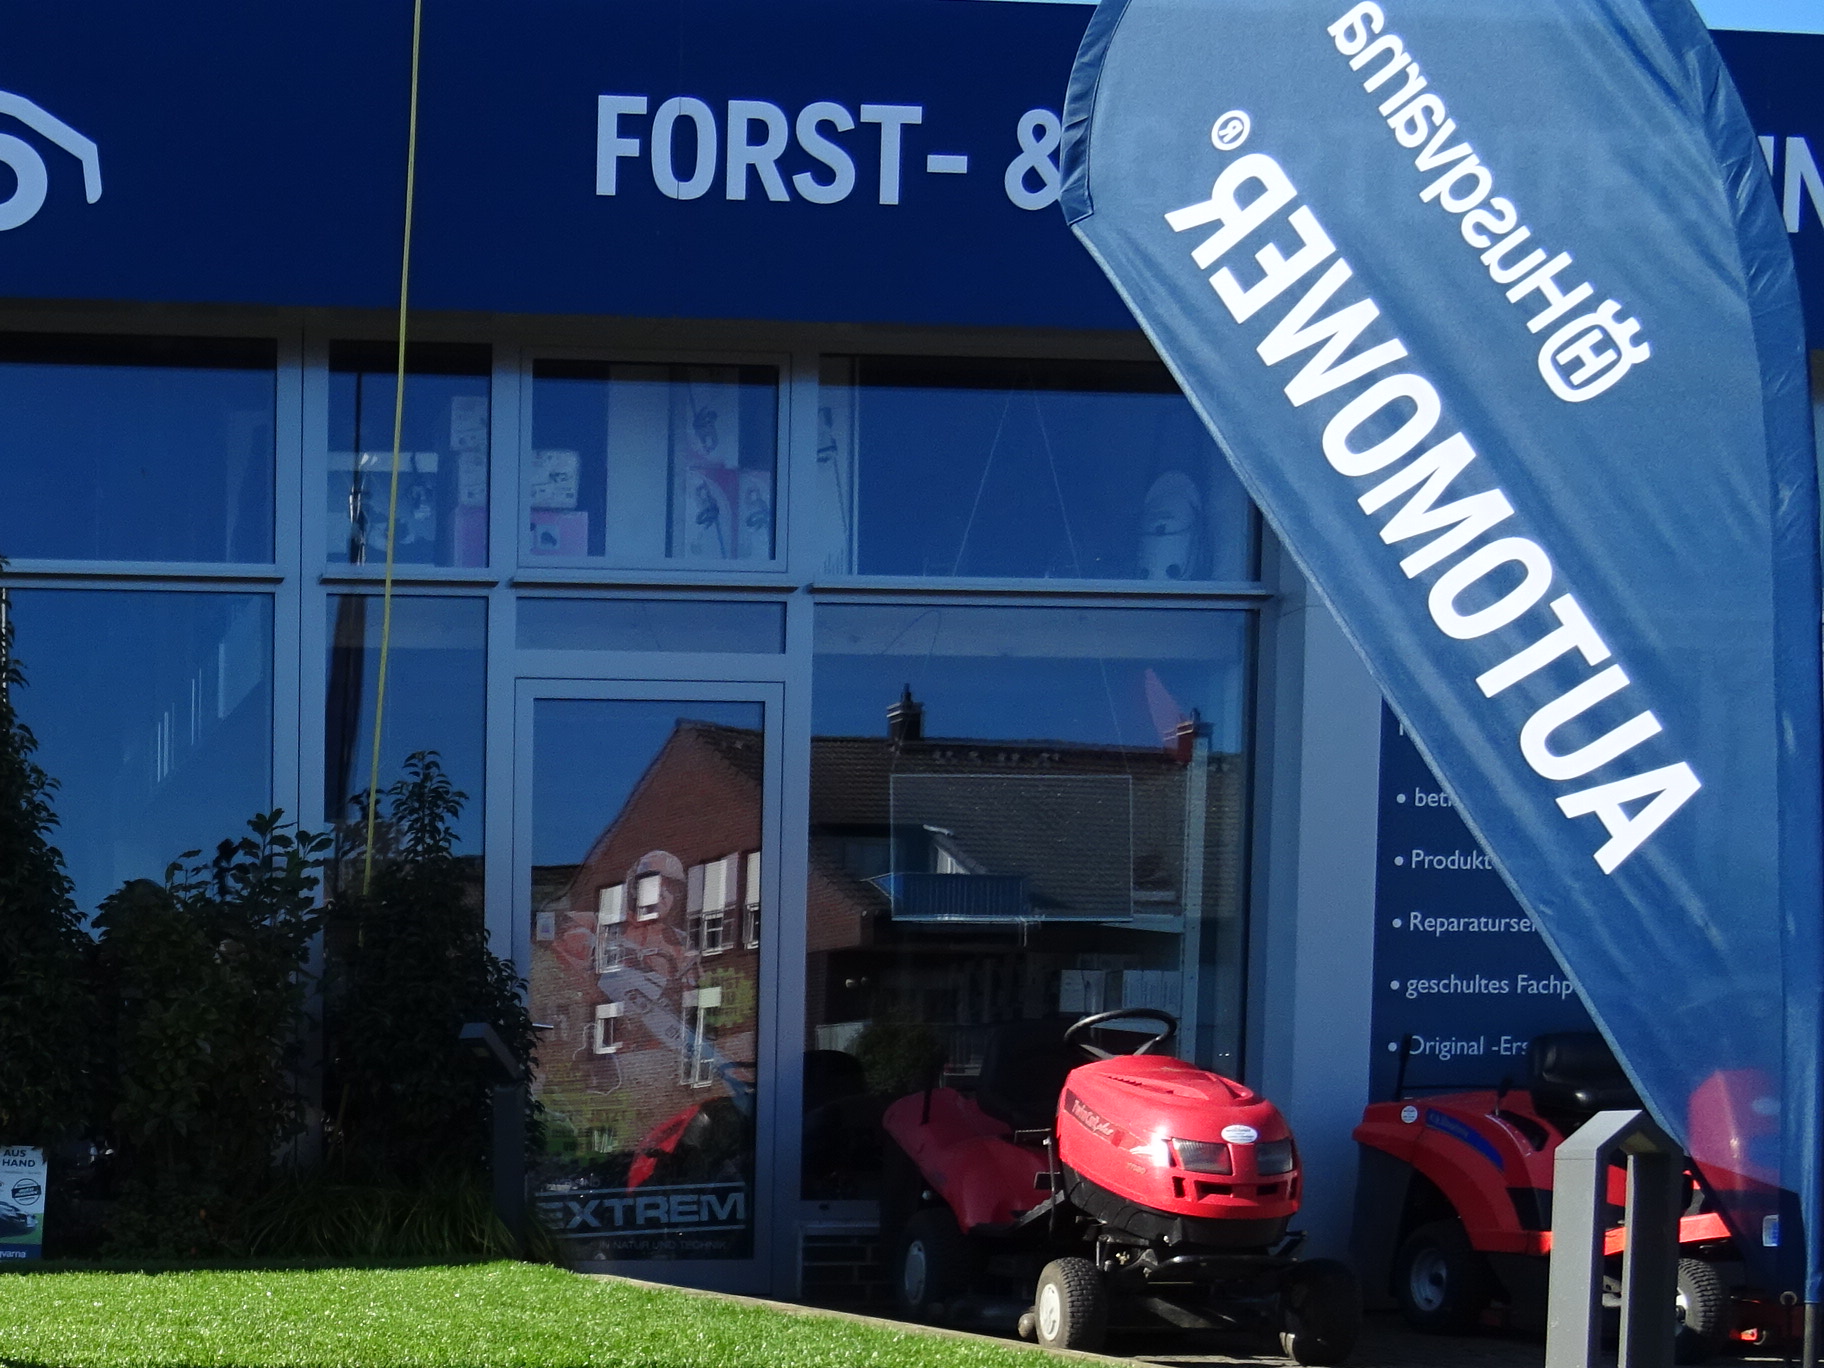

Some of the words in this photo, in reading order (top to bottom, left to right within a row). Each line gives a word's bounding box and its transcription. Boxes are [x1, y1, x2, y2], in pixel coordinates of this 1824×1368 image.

[595, 93, 969, 206] FORST-
[1004, 108, 1061, 211] &
[1405, 974, 1510, 999] geschultes
[1517, 974, 1574, 1000] Fachp
[1409, 1035, 1484, 1061] Original
[2, 1158, 36, 1168] HAND
[3, 1149, 27, 1158] AUS
[536, 1191, 747, 1231] EXTREM
